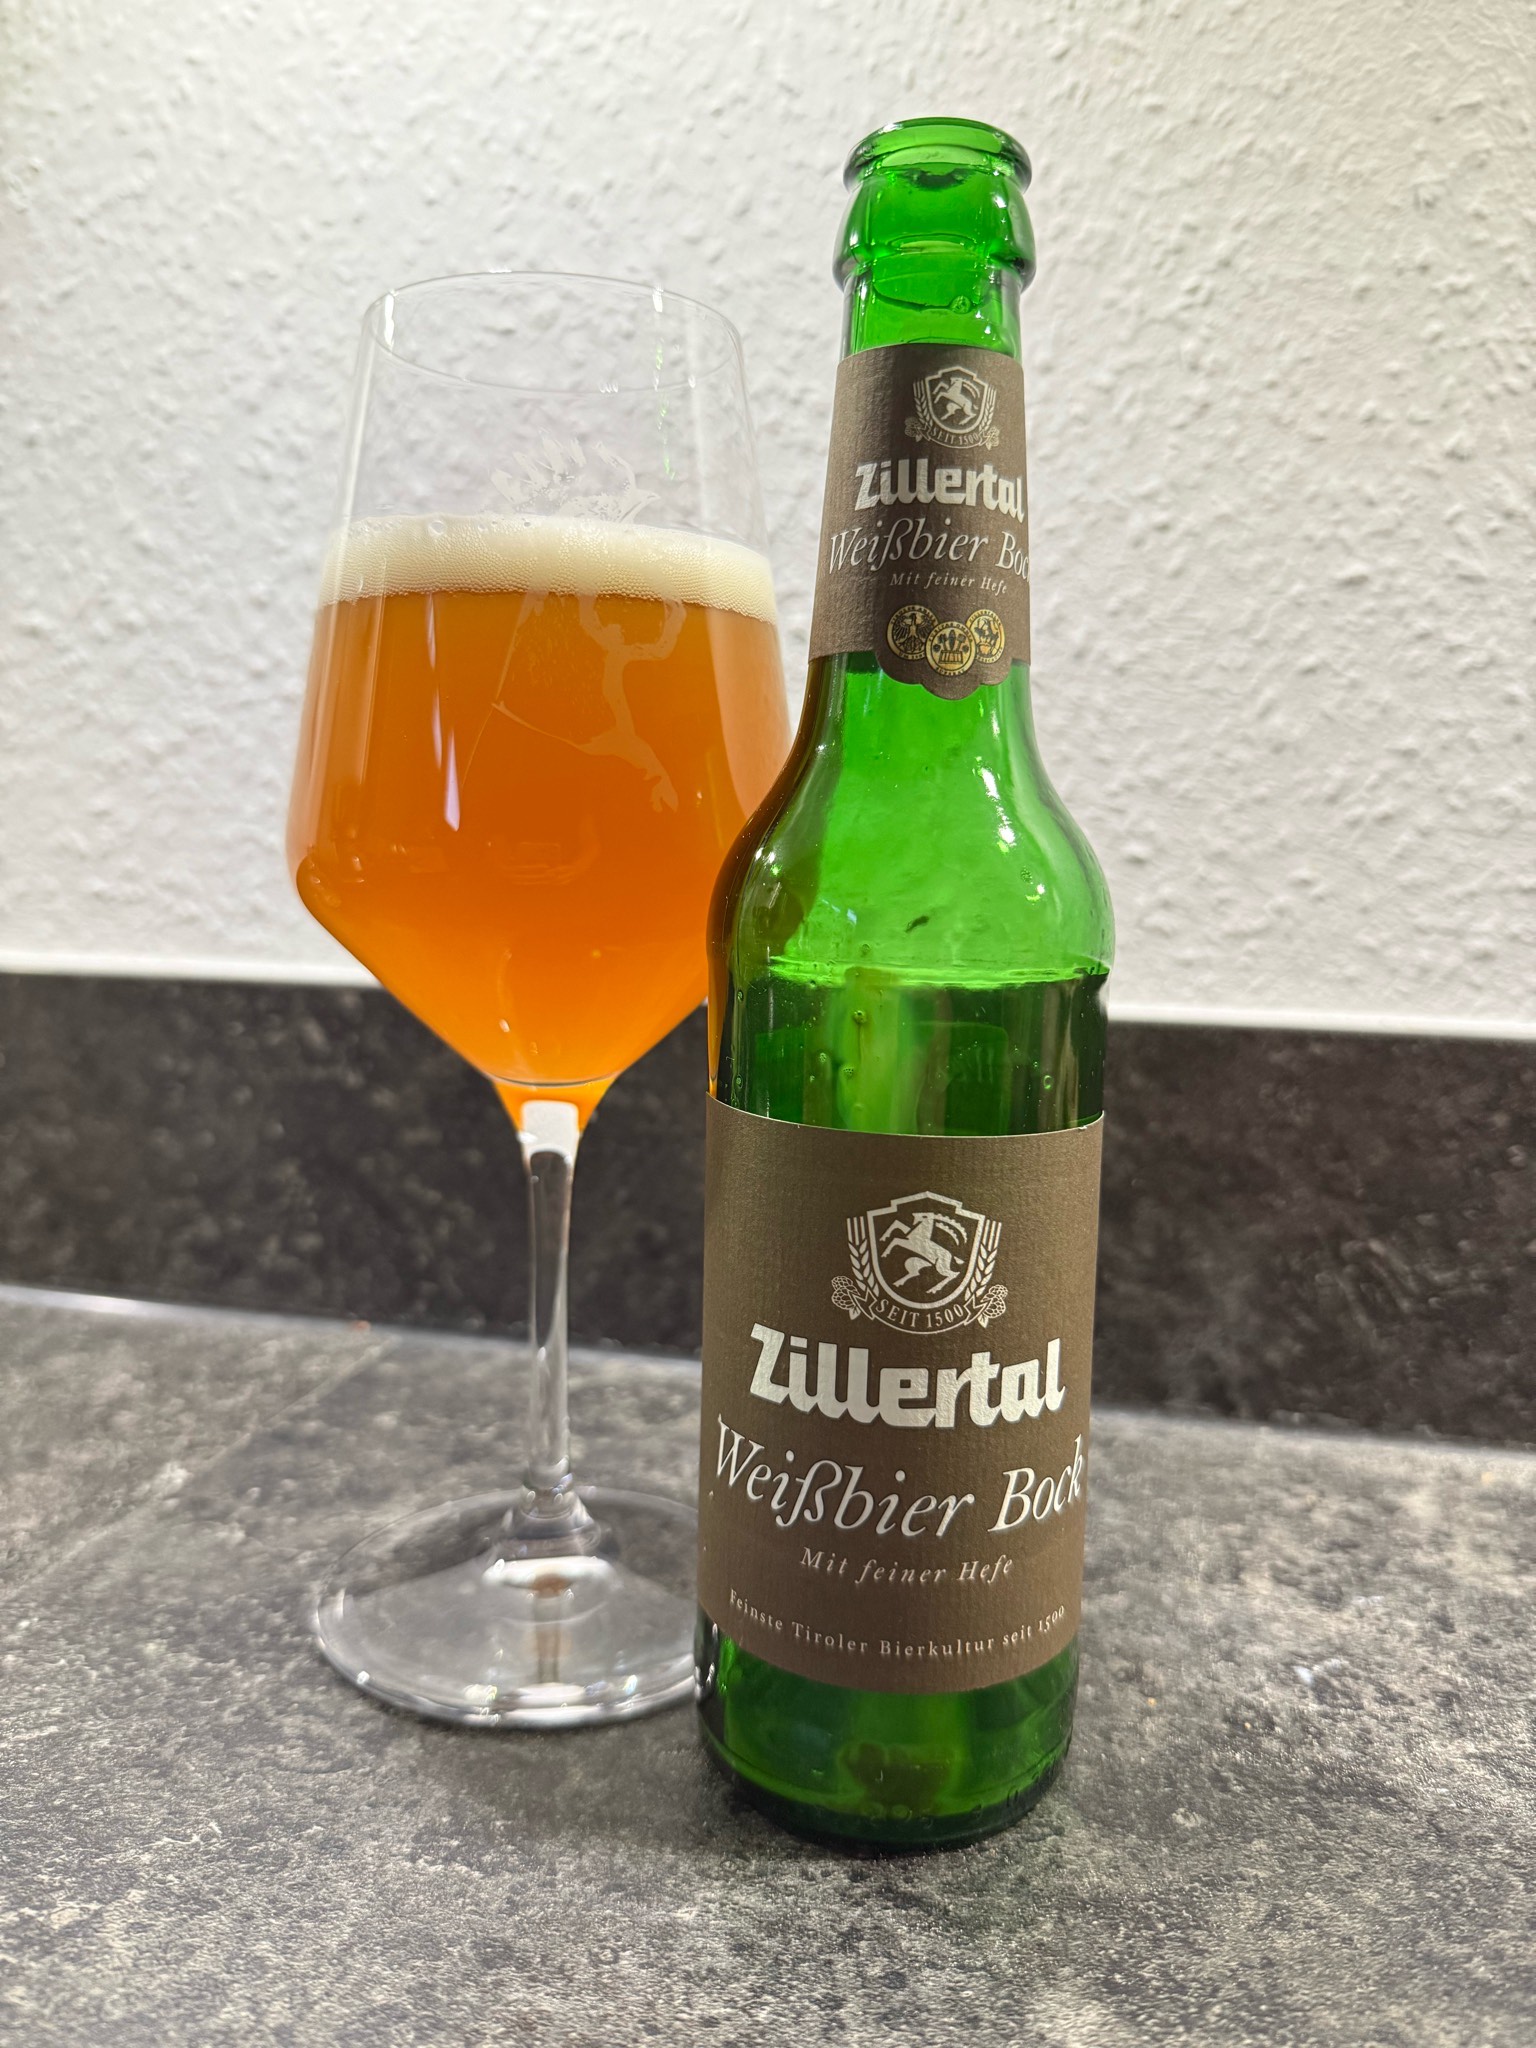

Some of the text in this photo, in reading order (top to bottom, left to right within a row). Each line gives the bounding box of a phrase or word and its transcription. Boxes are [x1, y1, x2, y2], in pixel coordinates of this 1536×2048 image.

[854, 457, 1025, 524] Zillertal
[829, 517, 1030, 583] Weißbier Boc
[889, 571, 1007, 597] Mit feiner Hefe
[875, 1298, 965, 1329] SEIT 1500
[750, 1322, 1067, 1429] Zillertal
[715, 1413, 1084, 1537] Weißbier Bock
[800, 1546, 1014, 1585] Mit feiner Hefe
[729, 1588, 1065, 1657] Feinste Tiroler Bierkultur seit 1500
